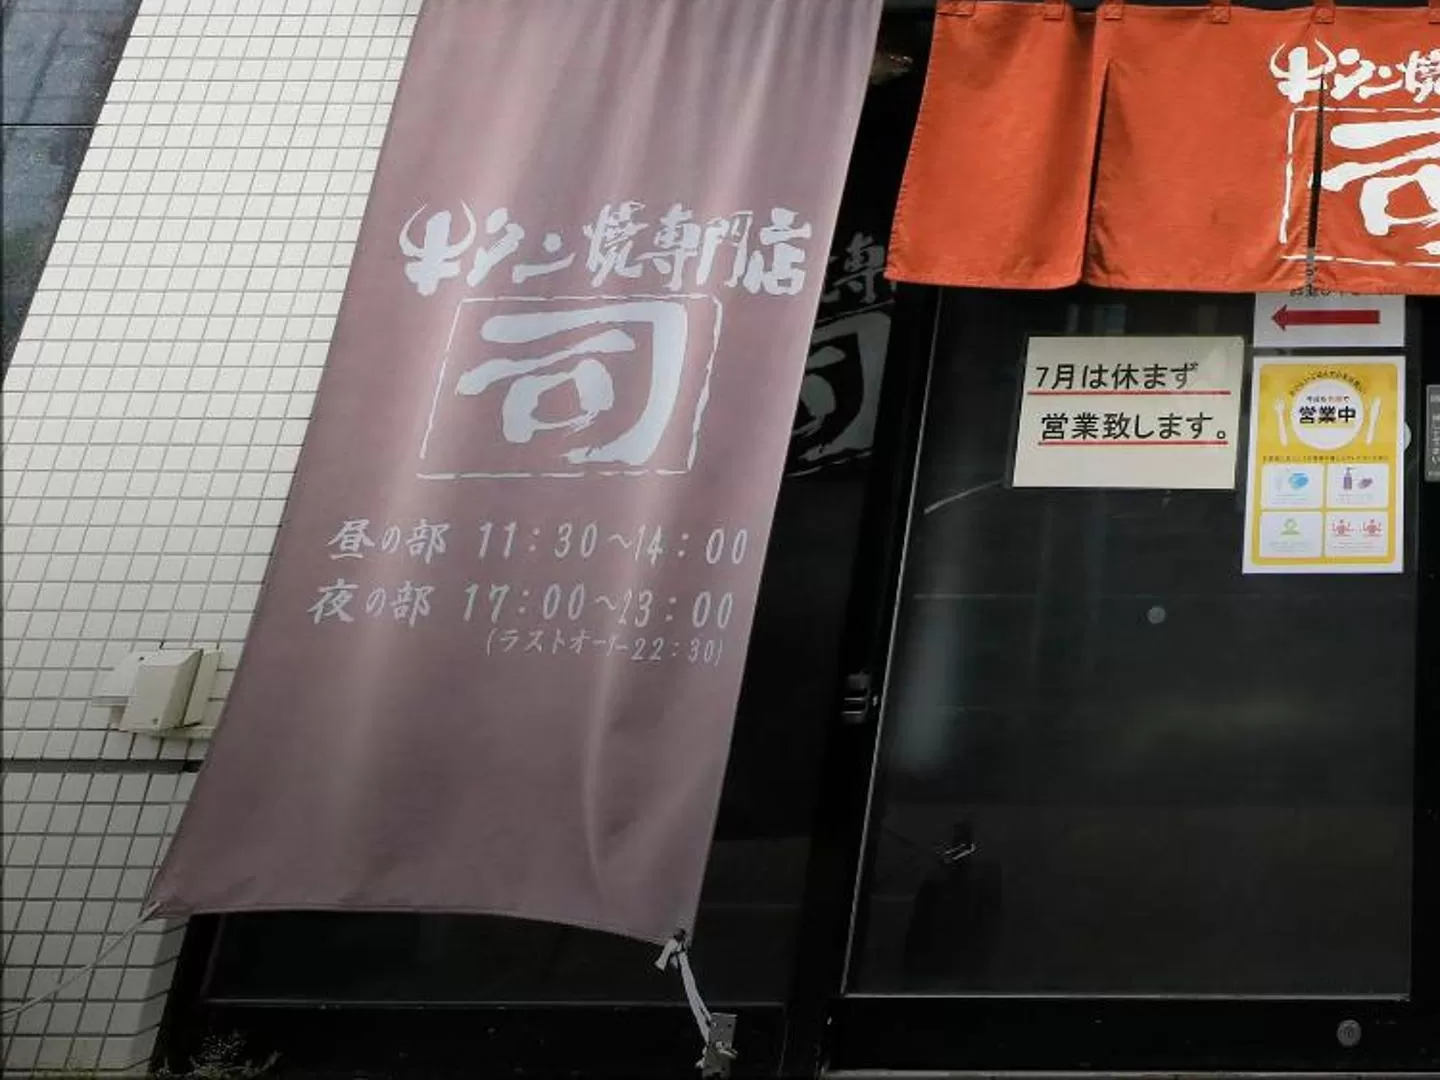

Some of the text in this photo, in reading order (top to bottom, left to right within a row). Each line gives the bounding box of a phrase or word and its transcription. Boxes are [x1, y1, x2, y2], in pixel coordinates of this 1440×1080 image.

[399, 200, 813, 296] 牛タン焼専門店
[455, 301, 689, 466] 司
[1035, 361, 1199, 391] 7月は休まず
[1040, 412, 1228, 442] 営業致します。
[1299, 405, 1357, 424] 営業中
[327, 517, 450, 564] 昼の部
[307, 577, 434, 628] 夜の部
